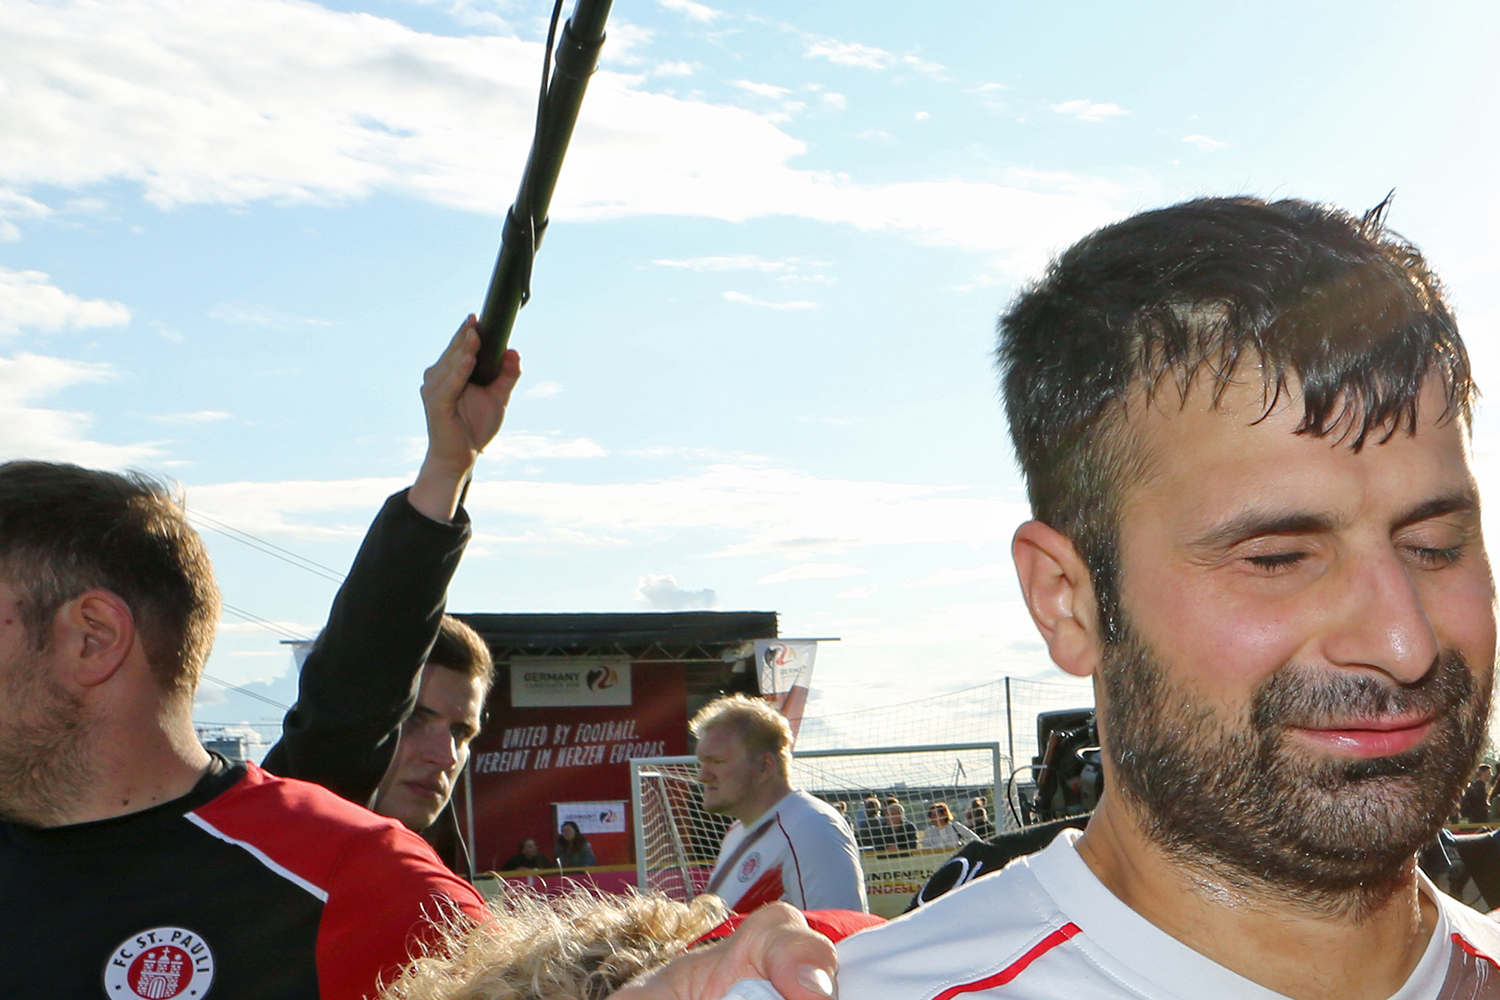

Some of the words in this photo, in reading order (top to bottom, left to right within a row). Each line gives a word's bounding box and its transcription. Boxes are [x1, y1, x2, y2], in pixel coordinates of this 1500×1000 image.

[523, 671, 580, 682] GERMANY
[503, 726, 548, 749] UNITED
[553, 724, 571, 746] BY
[574, 720, 640, 744] FOOTBALL.
[475, 749, 531, 774] VEREINT
[534, 748, 552, 770] IM
[555, 743, 606, 768] HERZEN
[609, 741, 666, 764] EUROPAS
[113, 948, 133, 968] FC
[136, 932, 163, 949] ST.
[171, 930, 210, 973] PAULI
